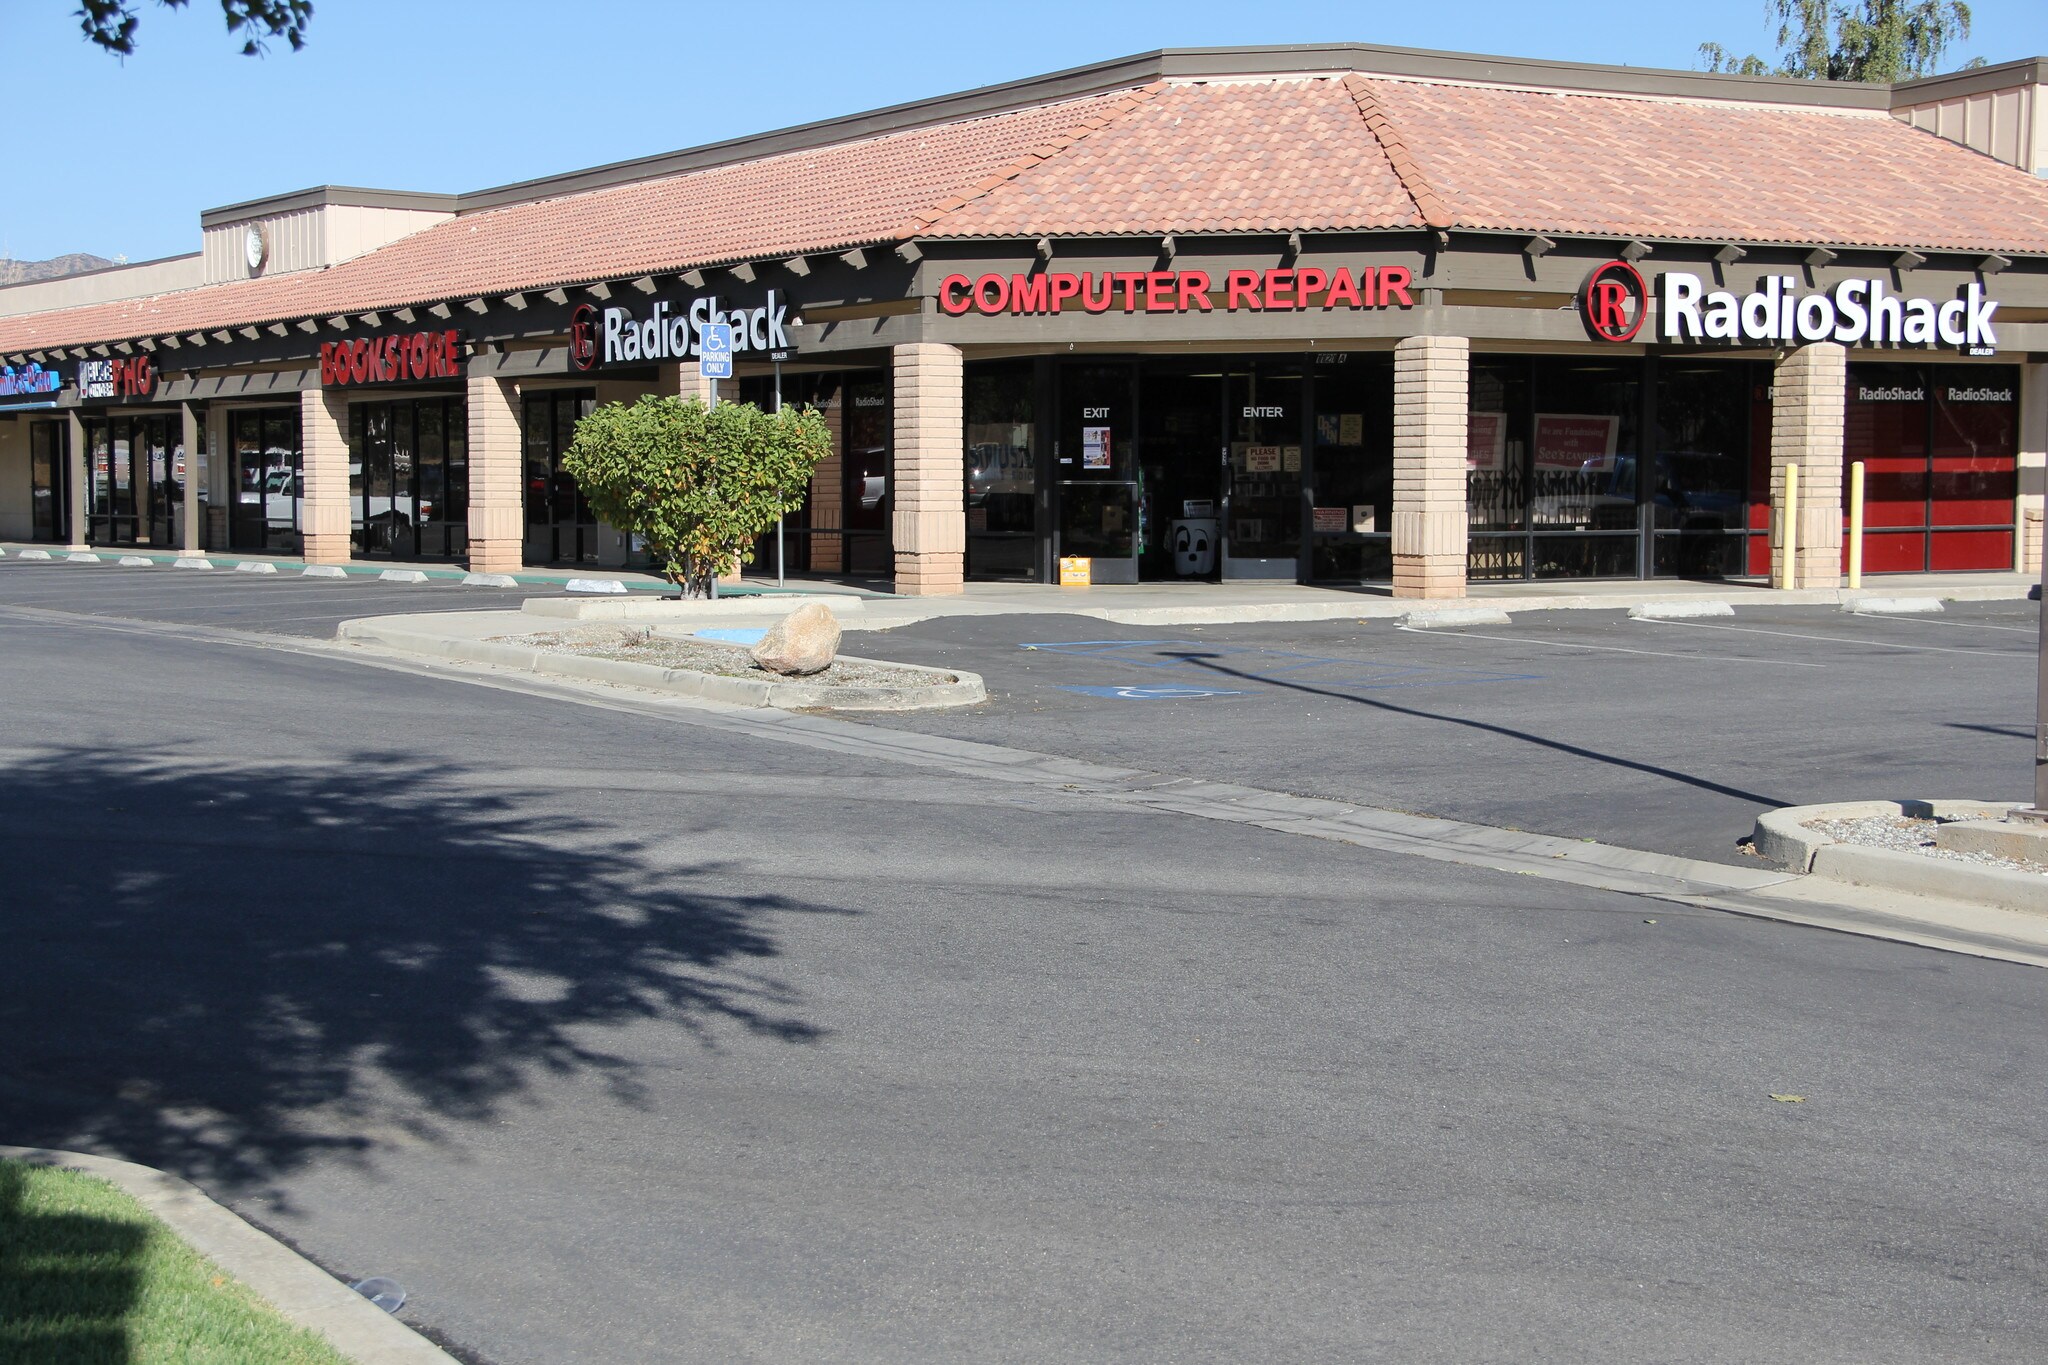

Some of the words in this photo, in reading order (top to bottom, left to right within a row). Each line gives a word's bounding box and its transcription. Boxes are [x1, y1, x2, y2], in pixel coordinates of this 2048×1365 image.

[940, 271, 1212, 314] COMPUTER
[1229, 266, 1414, 311] REPAIR
[1664, 272, 1999, 345] RadioShack
[320, 329, 459, 386] BOOKSTORE
[702, 351, 730, 363] PARKING
[771, 352, 788, 360] DEALER
[1969, 347, 1994, 356] DEALER
[706, 362, 725, 374] ONLY
[86, 359, 113, 382] BLUE
[112, 356, 151, 396] PHO
[1859, 386, 1924, 401] RadioShack
[1948, 387, 2012, 402] RadioShack
[1083, 407, 1110, 418] EXIT
[1243, 406, 1284, 418] ENTER
[1250, 447, 1277, 456] PLEASE
[1538, 446, 1566, 460] See's
